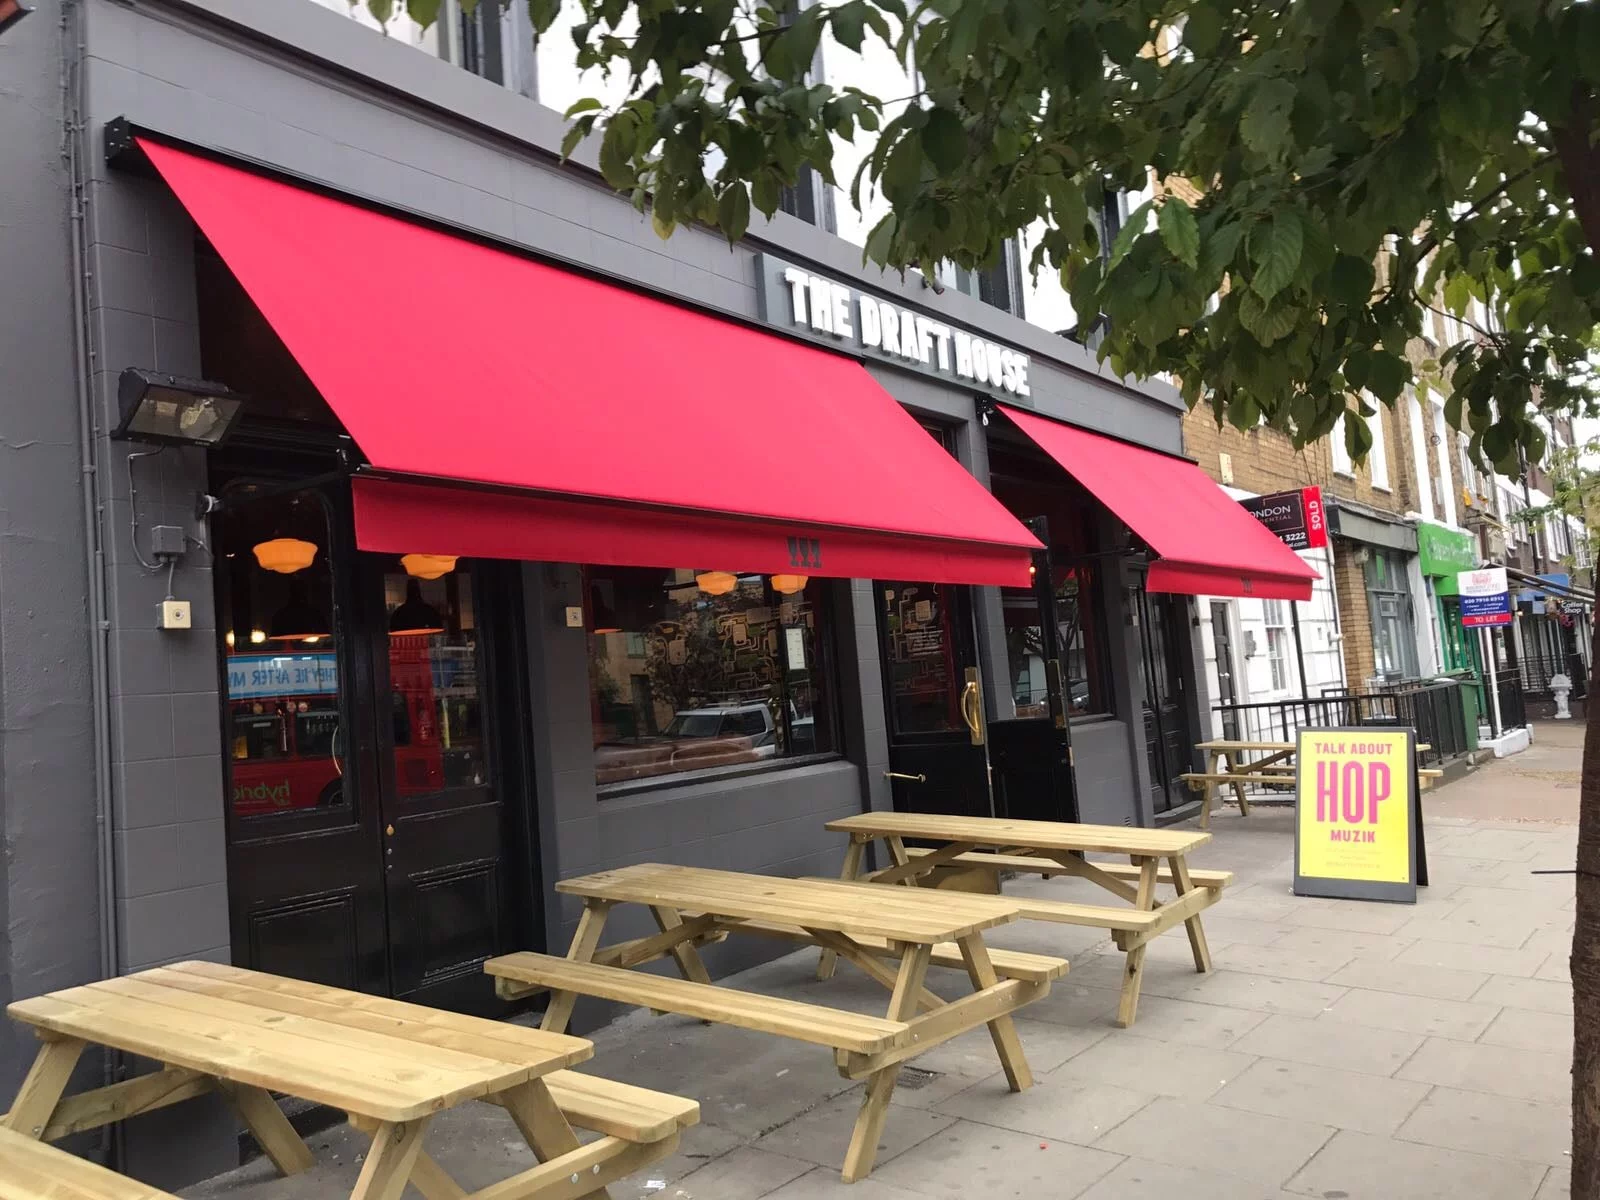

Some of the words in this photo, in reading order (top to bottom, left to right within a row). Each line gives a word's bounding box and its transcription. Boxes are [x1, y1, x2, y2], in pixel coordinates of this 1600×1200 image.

[784, 267, 853, 338] THE
[859, 295, 951, 370] DRAFT
[954, 331, 1031, 396] HOUSE
[1249, 505, 1291, 518] ONDON
[1309, 500, 1322, 530] SOLD
[1285, 532, 1306, 542] 3222
[1561, 601, 1584, 609] Coffee
[1315, 742, 1346, 755] TALK
[1350, 743, 1392, 755] ABOUT
[1316, 760, 1391, 825] HOP
[1331, 829, 1376, 843] MUZIK
